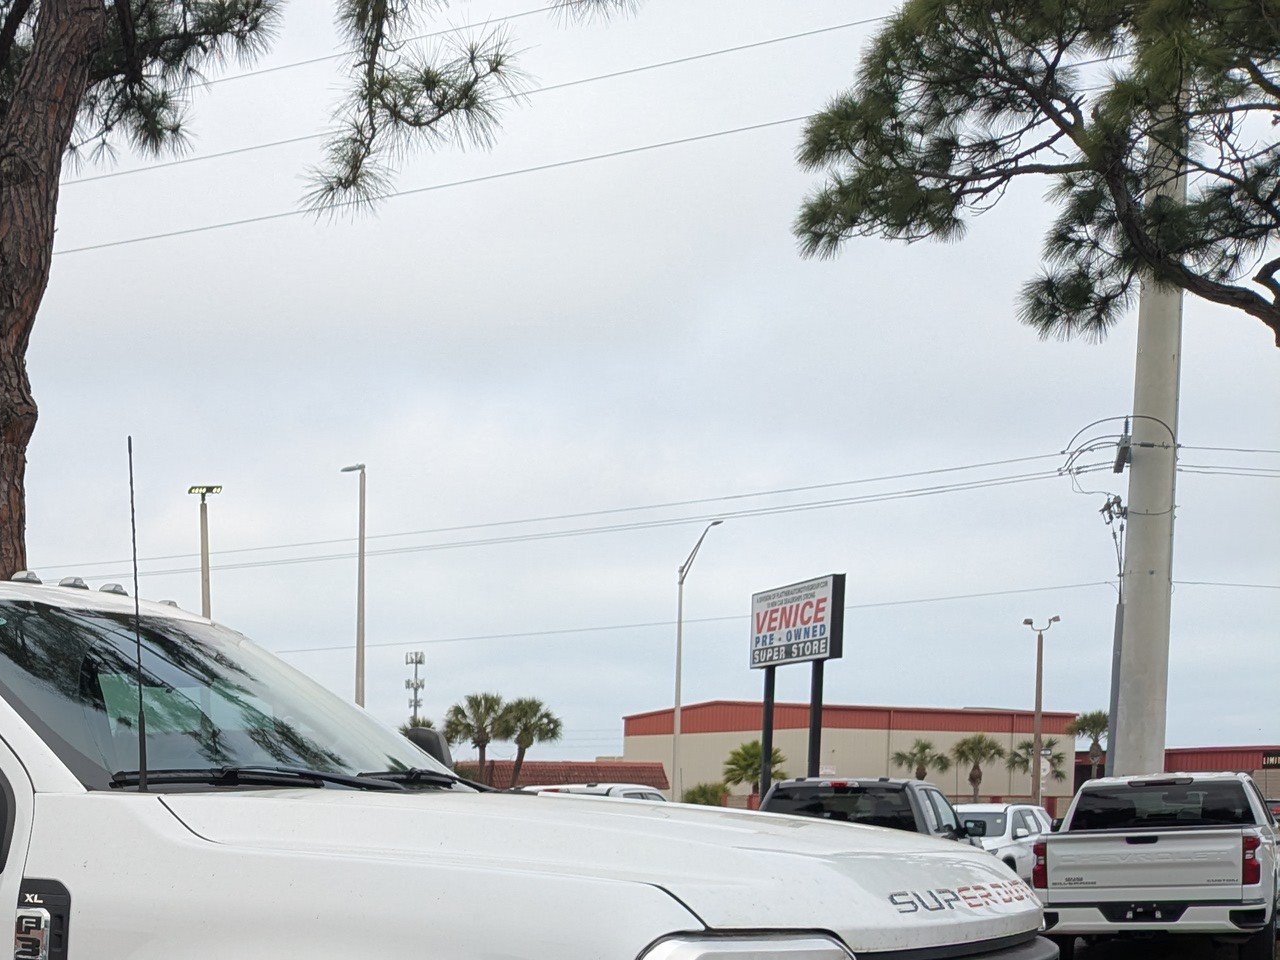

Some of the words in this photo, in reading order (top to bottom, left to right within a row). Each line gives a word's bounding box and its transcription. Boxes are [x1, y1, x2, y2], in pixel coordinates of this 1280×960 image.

[755, 597, 828, 634] VENICE
[753, 645, 786, 663] SUPER
[792, 638, 826, 658] STORE
[24, 893, 44, 904] XL
[888, 884, 999, 914] SUPER
